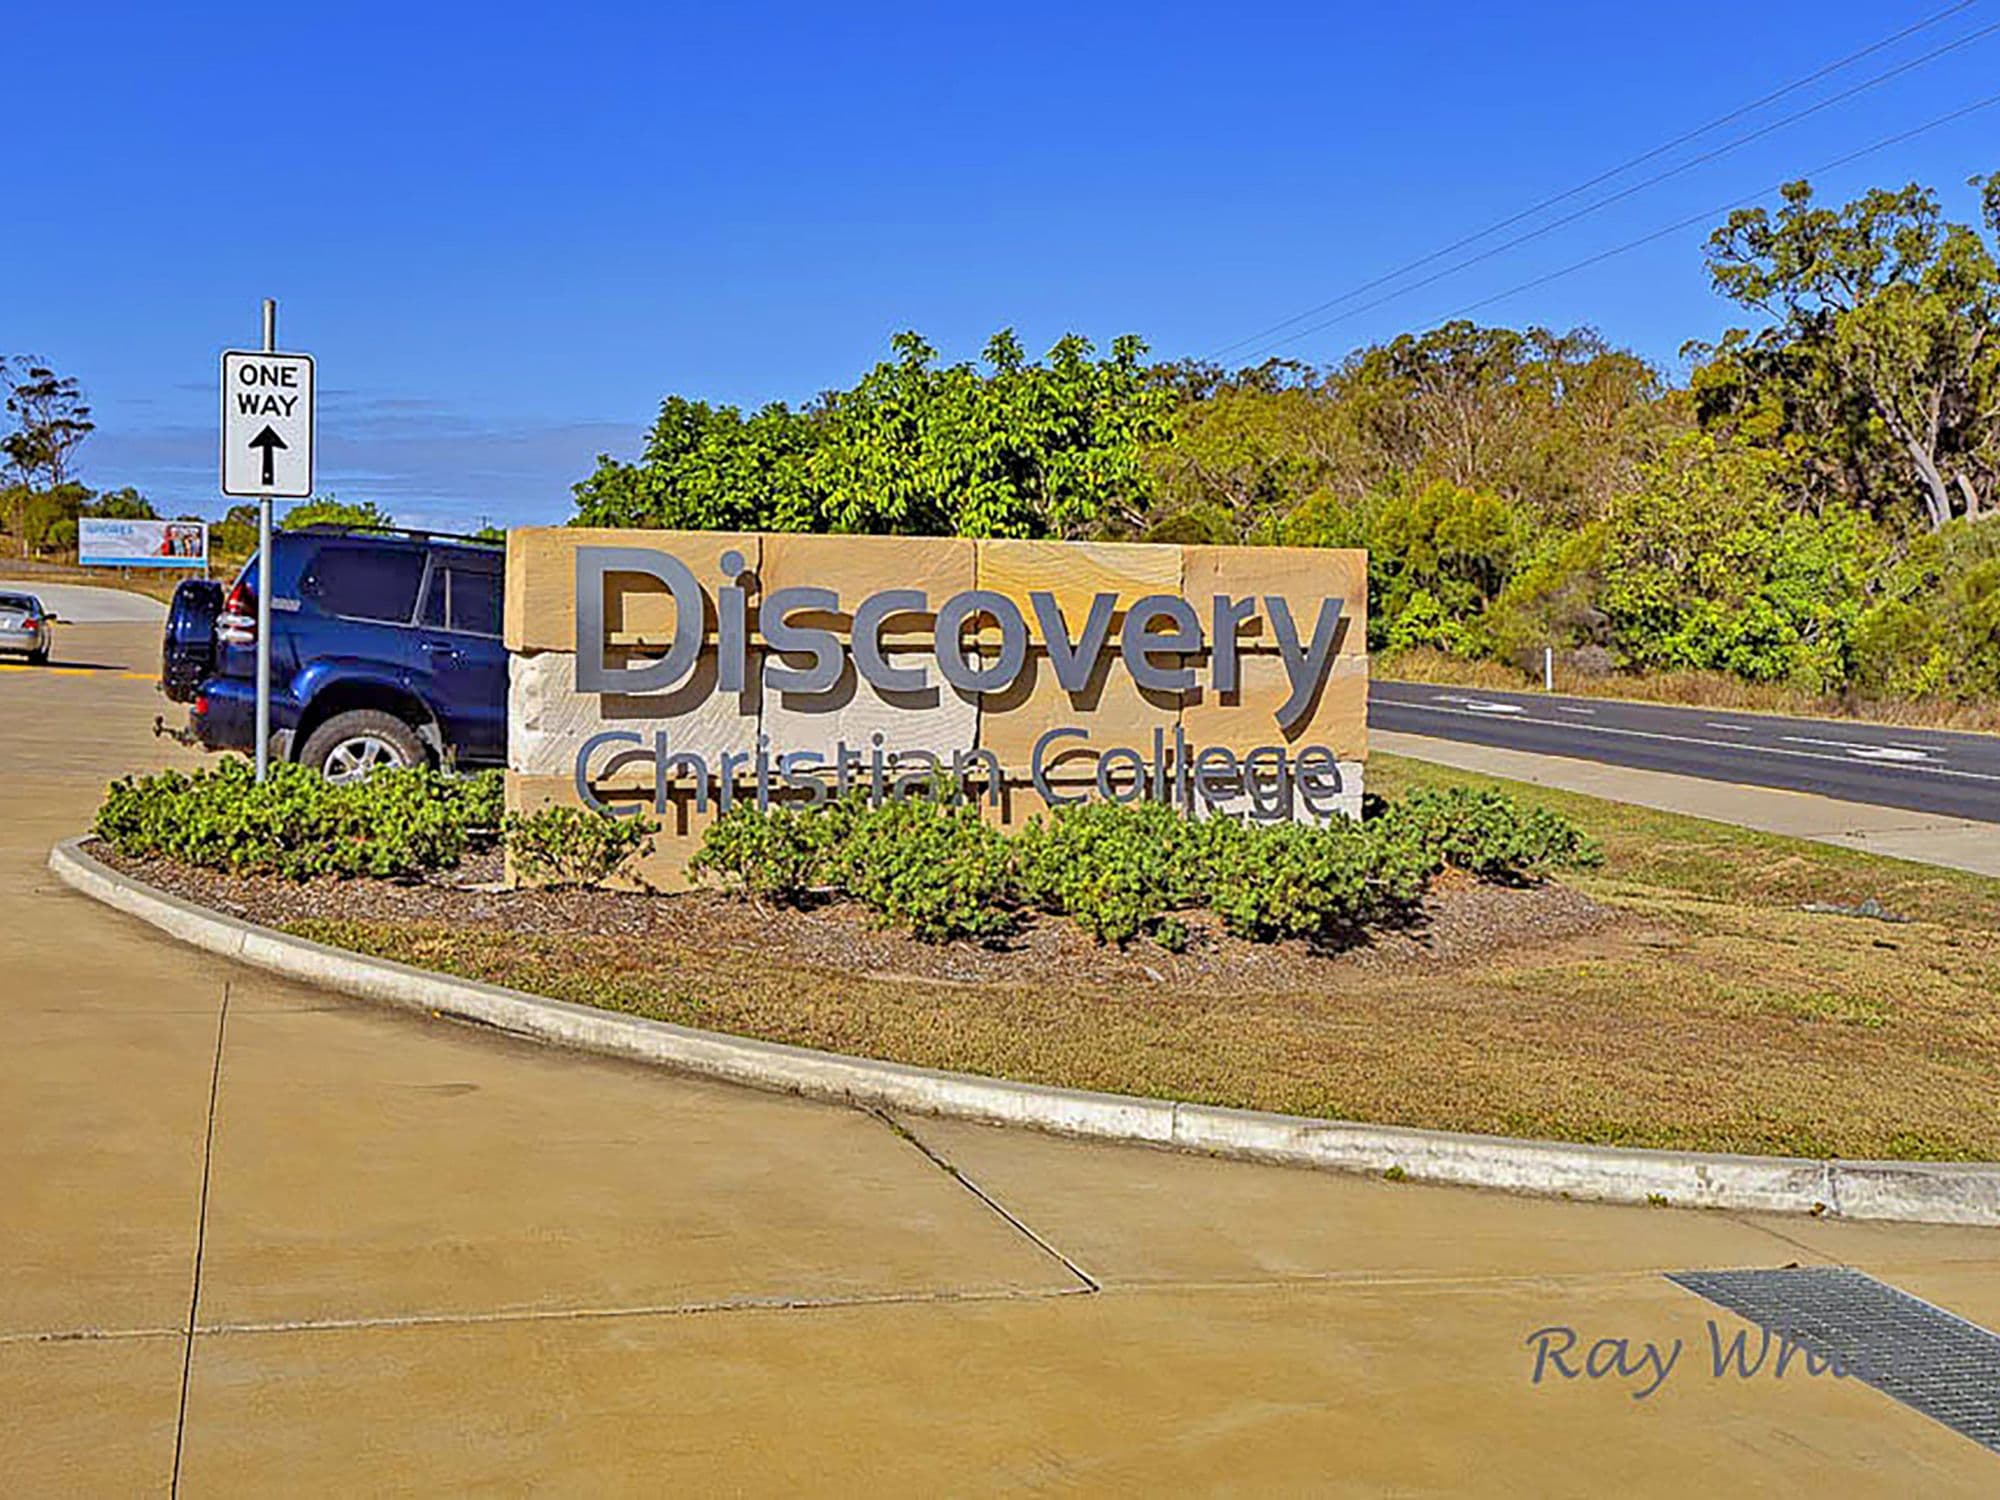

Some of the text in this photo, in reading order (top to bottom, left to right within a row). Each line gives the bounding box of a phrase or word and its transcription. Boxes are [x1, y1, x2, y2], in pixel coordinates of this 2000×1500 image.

[237, 392, 298, 417] WAY
[239, 364, 298, 388] ONE
[575, 546, 1345, 730] Discovery
[575, 727, 1337, 819] Christian College
